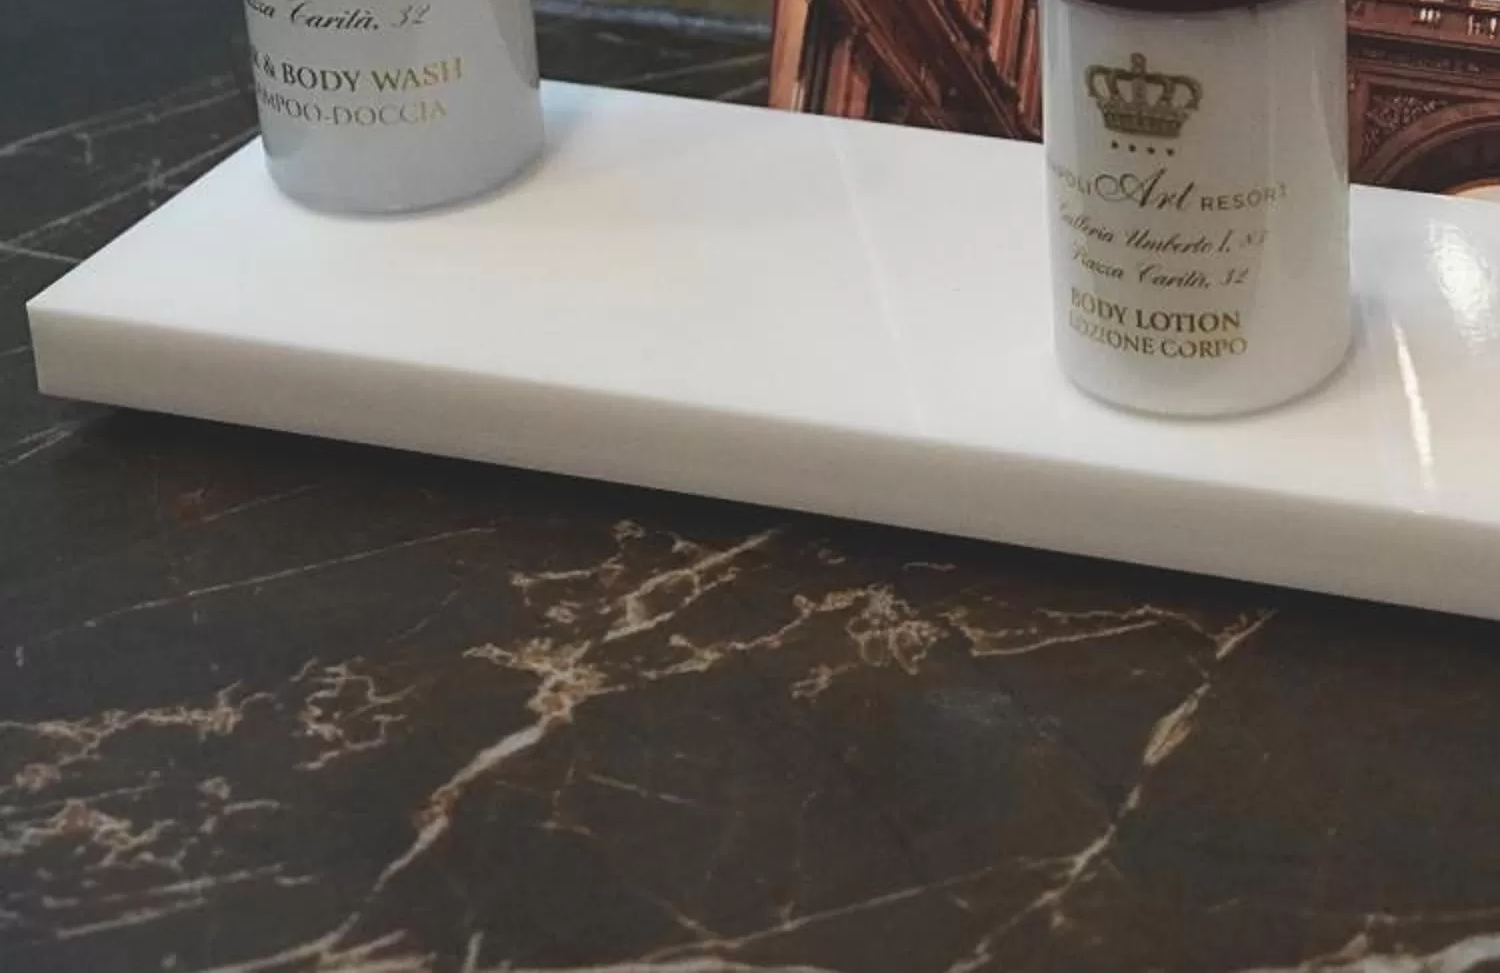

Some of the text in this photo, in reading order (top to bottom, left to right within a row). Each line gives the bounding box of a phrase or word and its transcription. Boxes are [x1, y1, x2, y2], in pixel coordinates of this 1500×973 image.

[281, 61, 361, 92] BODY
[370, 55, 463, 92] WASH
[1201, 181, 1287, 211] RESORT
[1126, 229, 1213, 254] Umberto
[1071, 286, 1241, 334] BODY LOTION
[1069, 310, 1248, 358] LOZIONE CORPO
